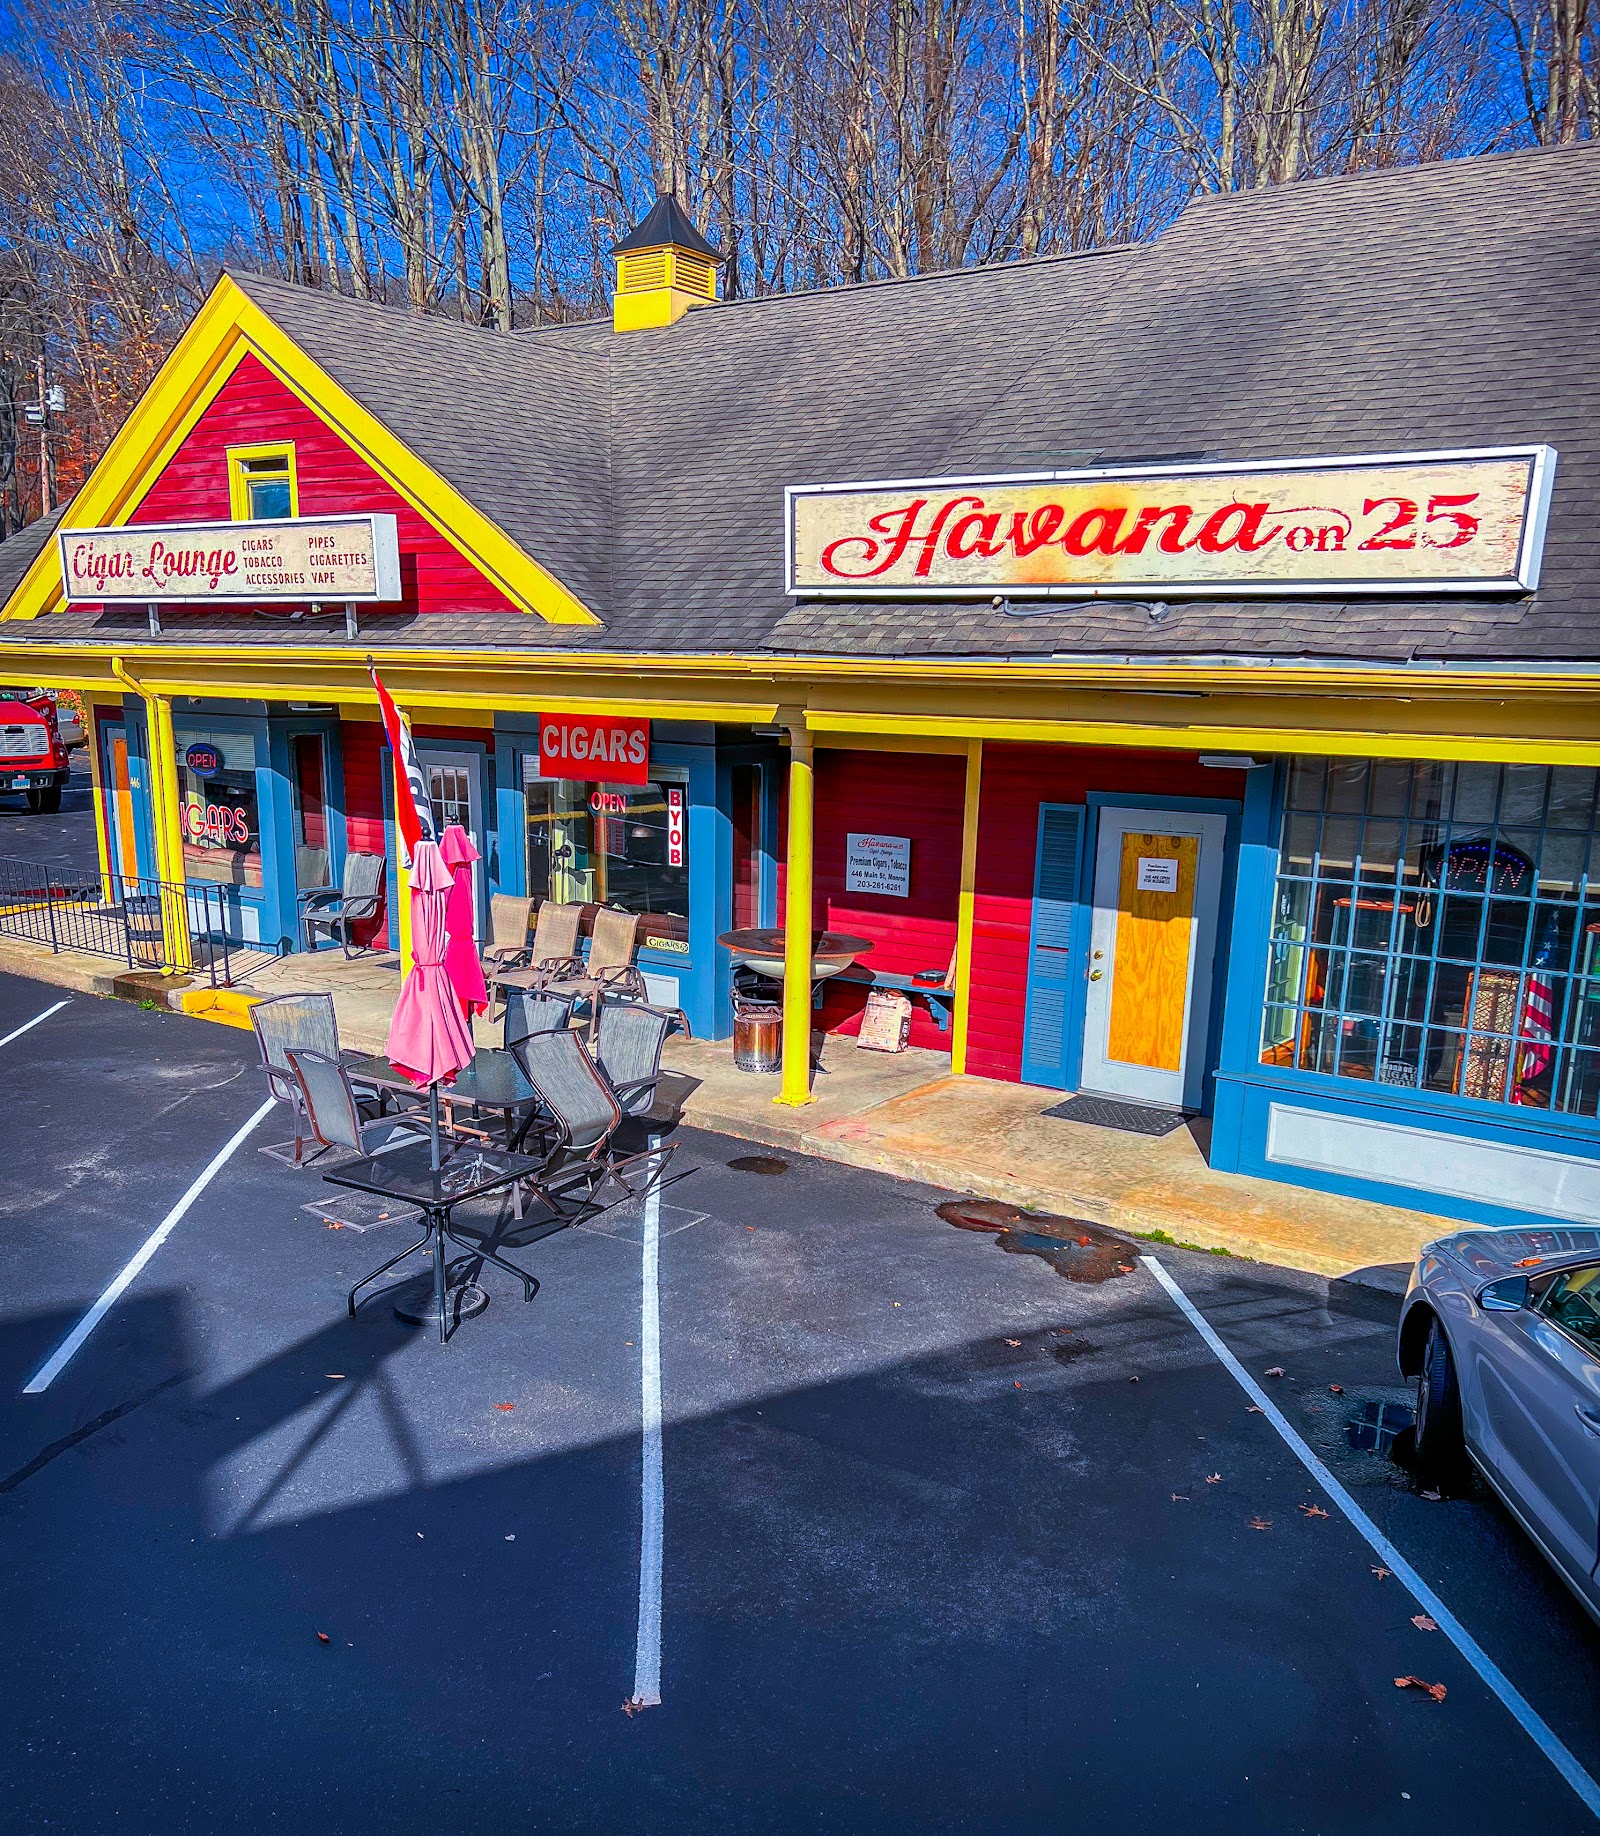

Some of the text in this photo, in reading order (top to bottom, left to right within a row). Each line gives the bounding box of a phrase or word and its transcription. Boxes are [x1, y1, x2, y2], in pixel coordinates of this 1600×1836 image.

[820, 490, 1482, 578] Havana on 25
[241, 538, 274, 551] CIGARS
[308, 536, 335, 549] PIPES
[73, 541, 239, 591] Cigar Lounge
[243, 556, 283, 568] TOBACCO
[309, 553, 367, 566] CIGARETTES
[245, 572, 305, 585] ACCESSORIES
[311, 572, 336, 584] VAPE
[542, 724, 646, 765] CIGARS
[188, 753, 217, 768] OPEN
[591, 791, 627, 814] OPEN
[180, 802, 249, 843] IGARS
[669, 791, 681, 865] BYOB
[857, 837, 892, 848] Havana
[850, 855, 871, 866] Premium
[891, 859, 907, 870] Tobacco
[851, 870, 863, 878] 446
[863, 871, 878, 879] Main
[888, 874, 906, 882] Monroe
[1436, 854, 1525, 891] OPEN
[648, 937, 680, 950] CIGARS
